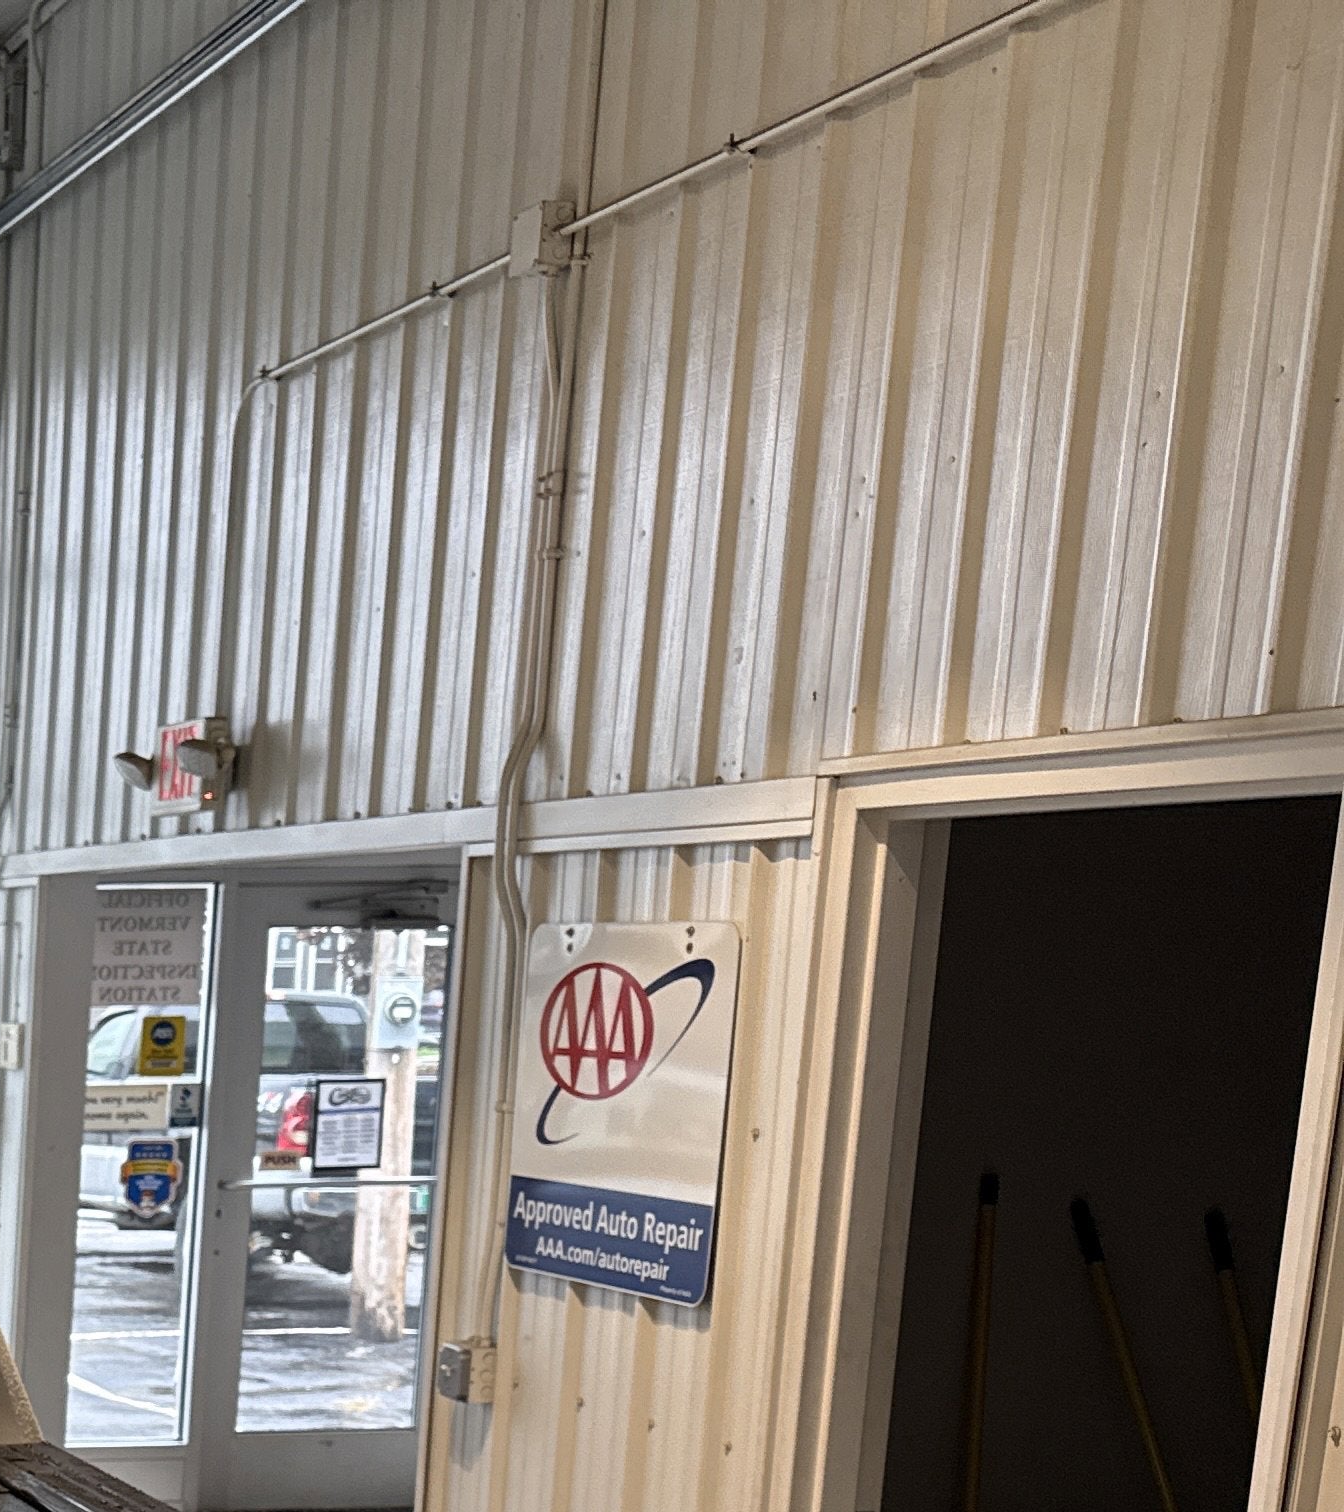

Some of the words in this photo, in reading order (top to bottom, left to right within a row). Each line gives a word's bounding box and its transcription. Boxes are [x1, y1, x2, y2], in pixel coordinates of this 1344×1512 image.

[550, 964, 642, 1097] AAA
[264, 1155, 297, 1166] PUSH
[513, 1191, 594, 1230] Approved
[595, 1204, 638, 1240] Auto
[642, 1212, 704, 1254] Repair
[535, 1236, 670, 1282] AAA.com/autorepair
